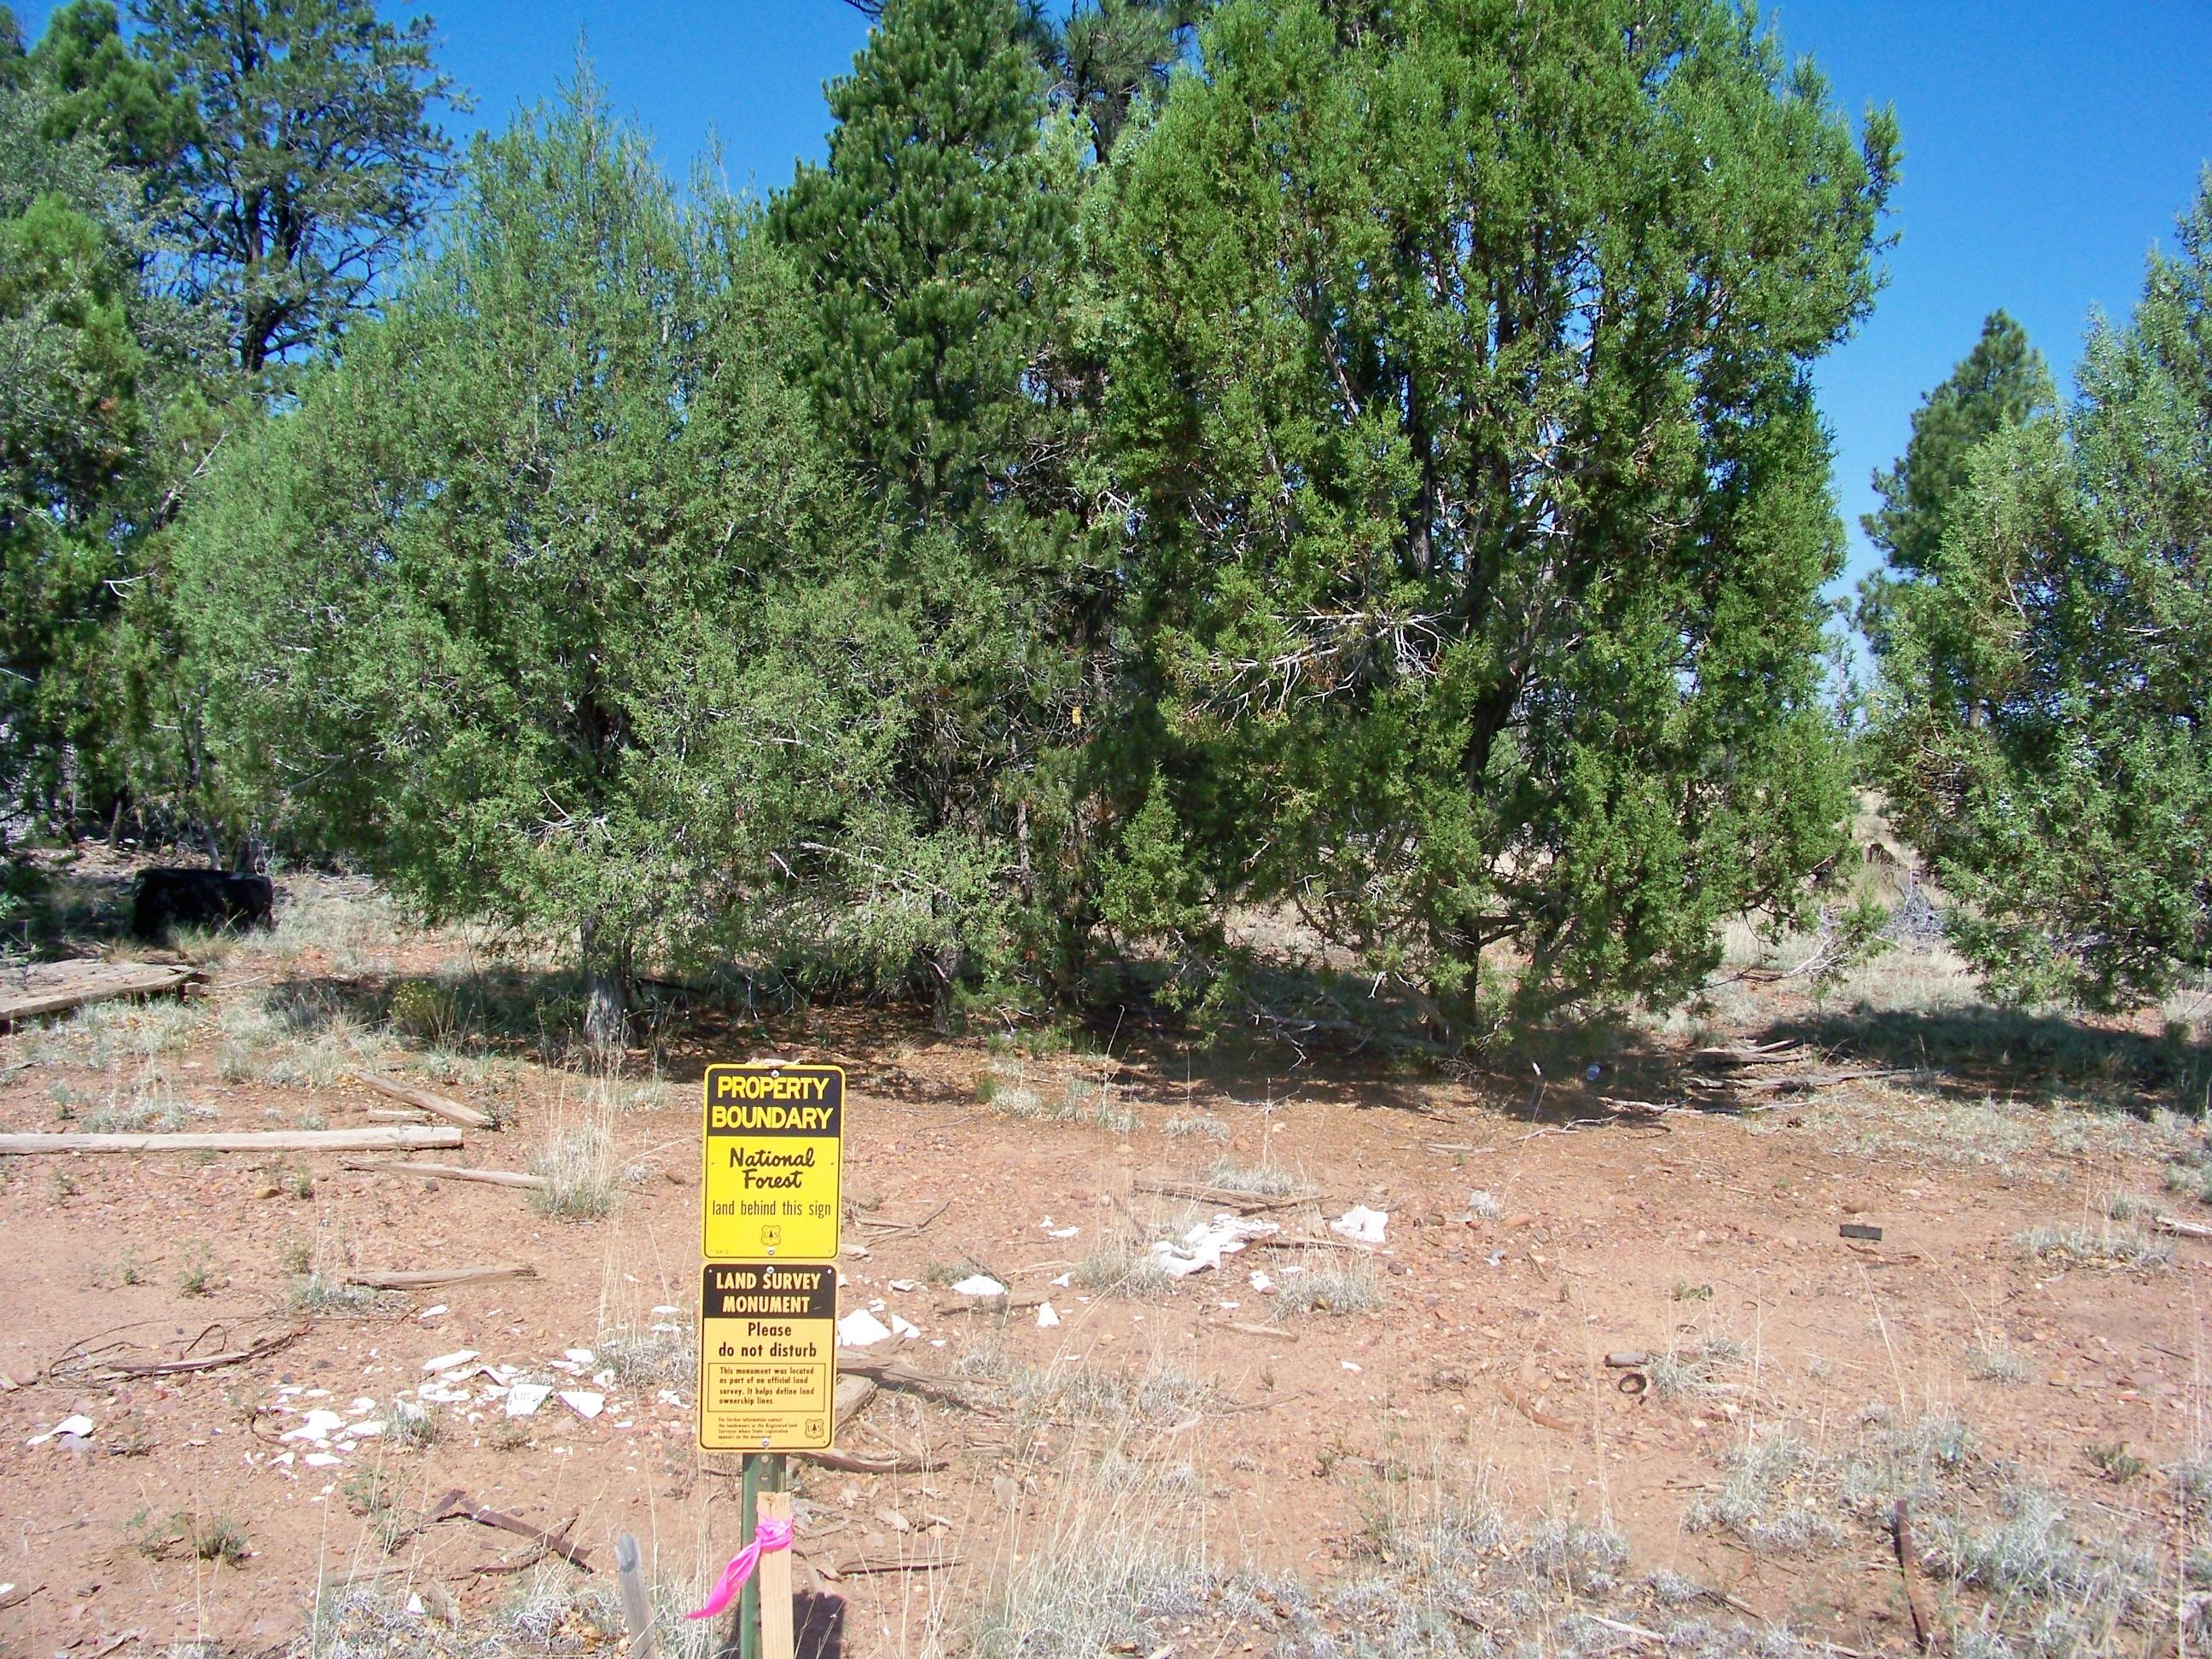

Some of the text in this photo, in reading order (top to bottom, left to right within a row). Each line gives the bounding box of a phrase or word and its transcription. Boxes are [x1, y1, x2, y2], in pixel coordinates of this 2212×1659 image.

[718, 1076, 830, 1099] PROPERTY
[712, 1106, 833, 1129] BOUNDARY
[730, 1147, 815, 1167] National
[742, 1168, 803, 1189] Forest
[713, 1201, 830, 1219] land behind this sign
[716, 1272, 821, 1289] LAND SURVEY
[722, 1296, 810, 1313] MONUMENT
[748, 1322, 792, 1336] Please
[719, 1342, 817, 1357] do not disturb
[789, 1366, 814, 1375] located
[755, 1388, 773, 1396] helps
